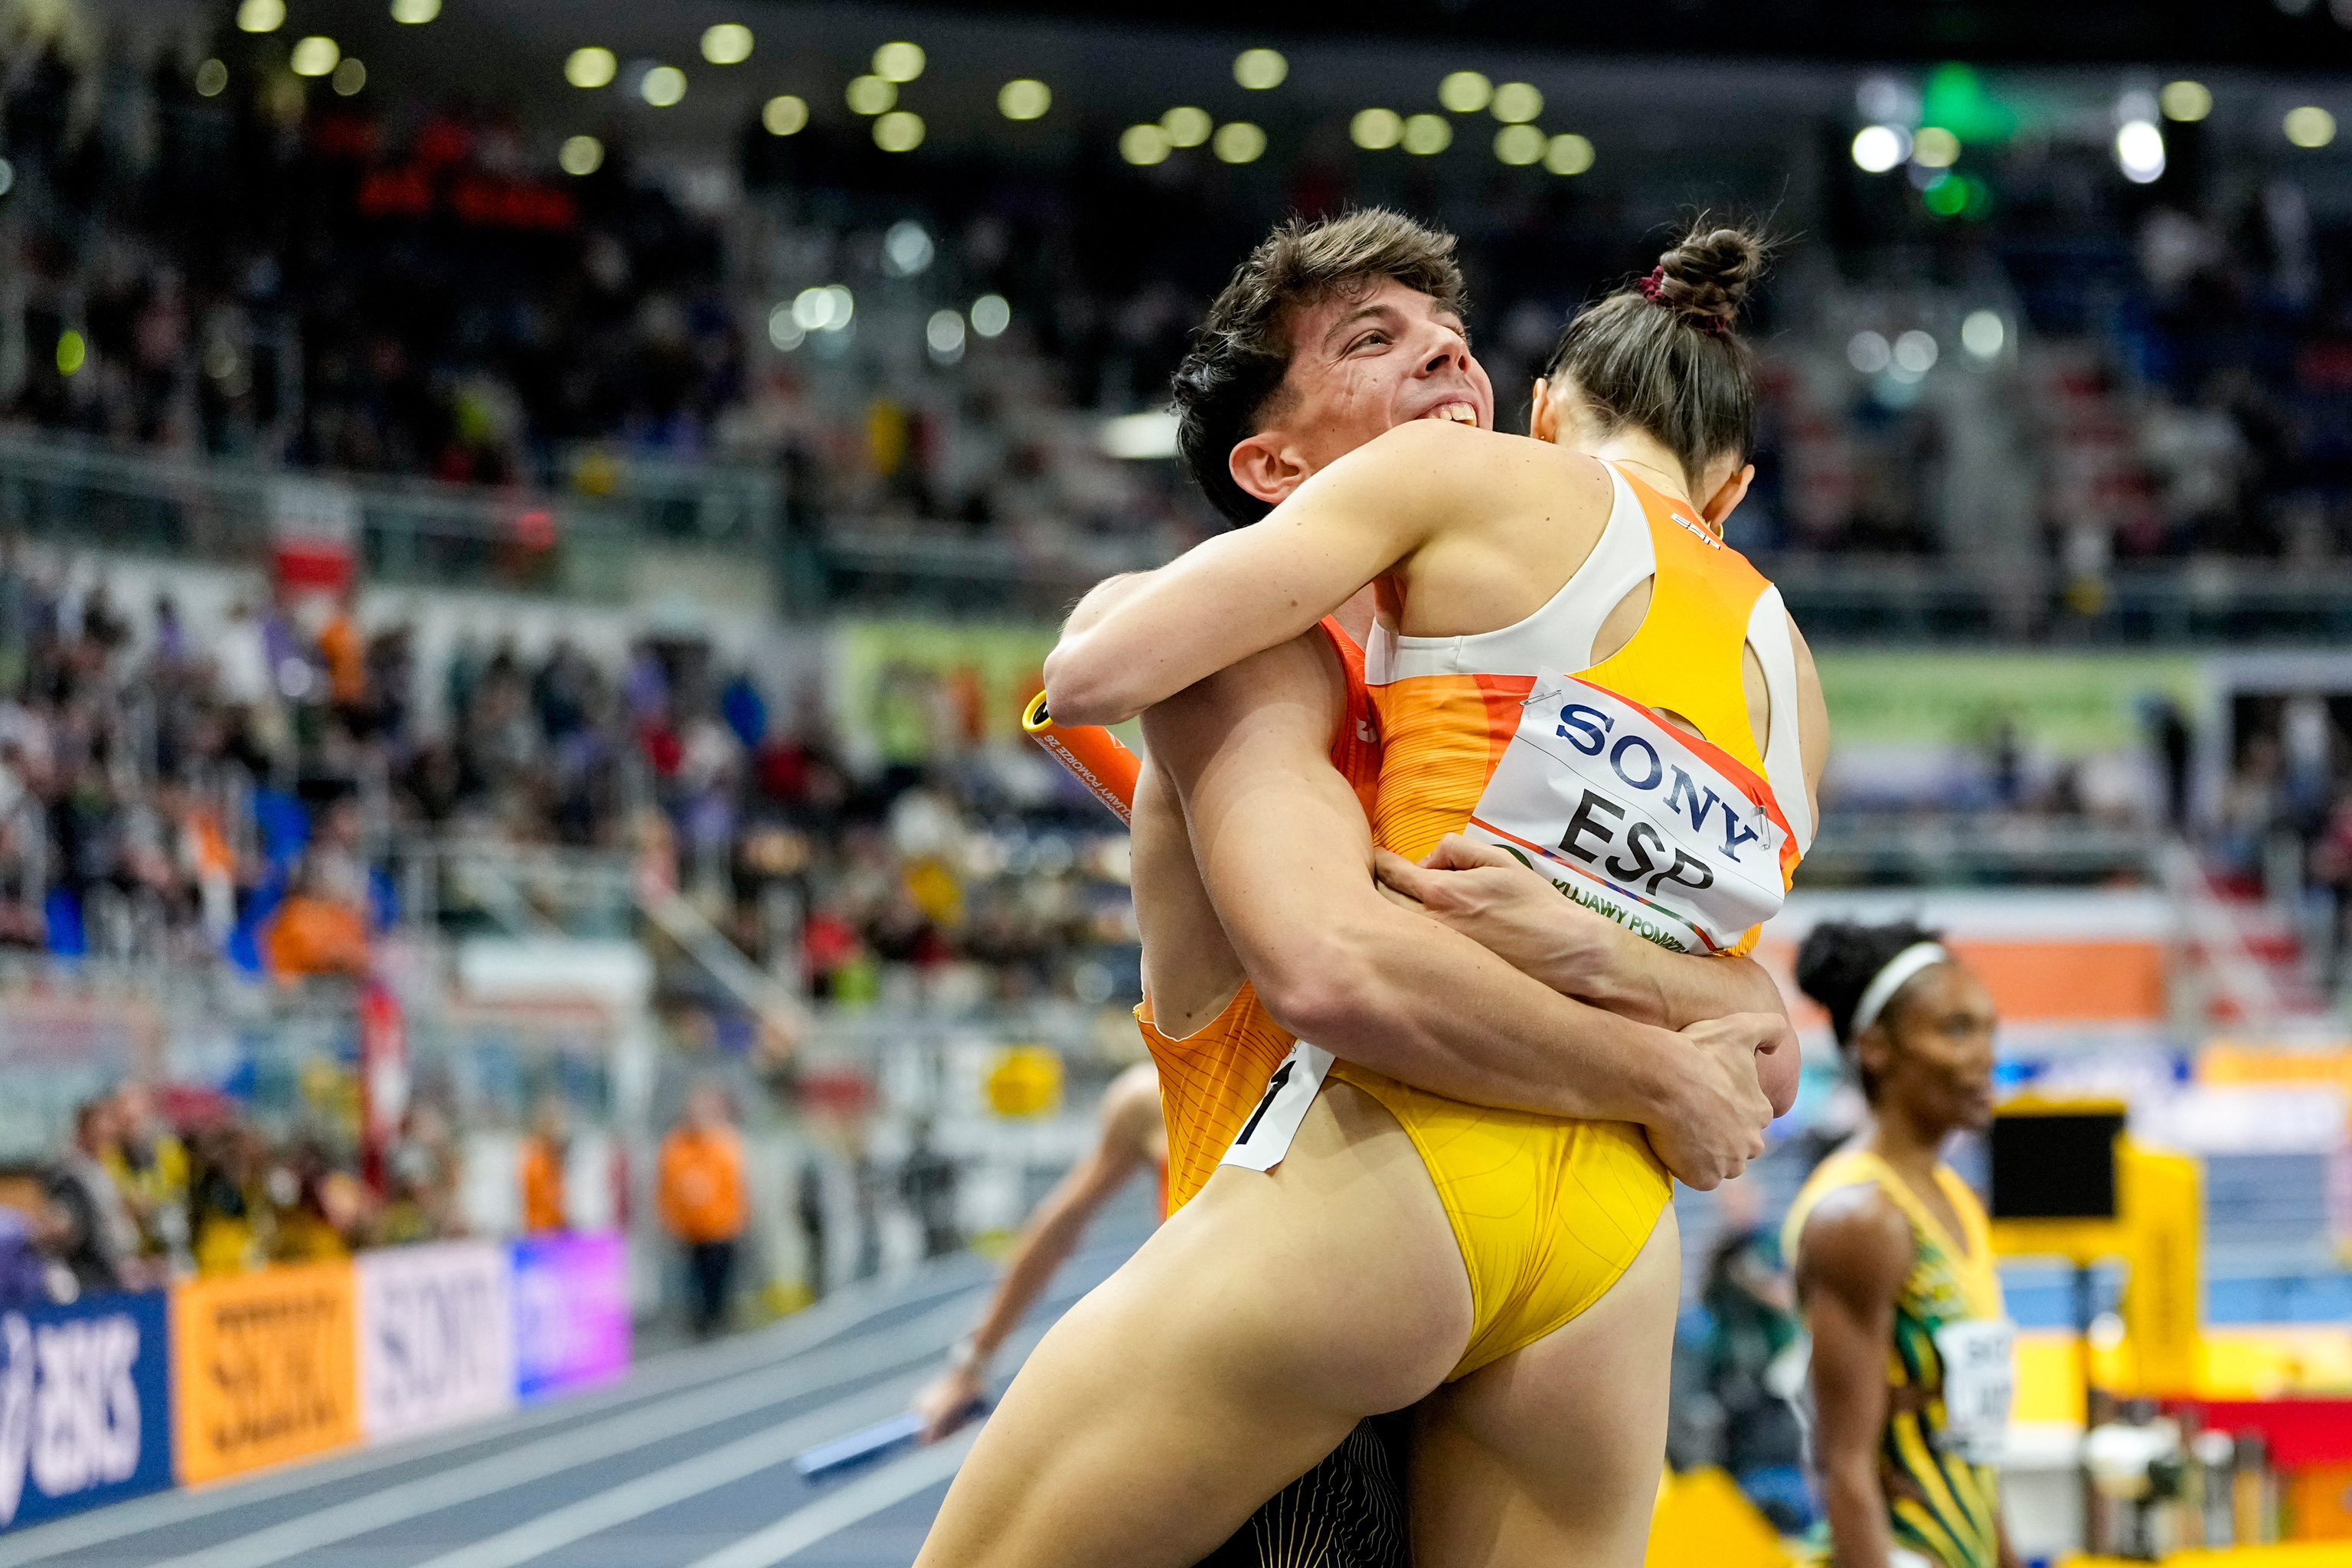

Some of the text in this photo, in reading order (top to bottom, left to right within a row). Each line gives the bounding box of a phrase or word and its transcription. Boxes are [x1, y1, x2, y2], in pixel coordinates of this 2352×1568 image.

[1044, 734, 1061, 748] 26
[1055, 746, 1102, 788] POMORZE
[1555, 704, 1759, 863] SONY
[1557, 788, 1714, 896] ESP
